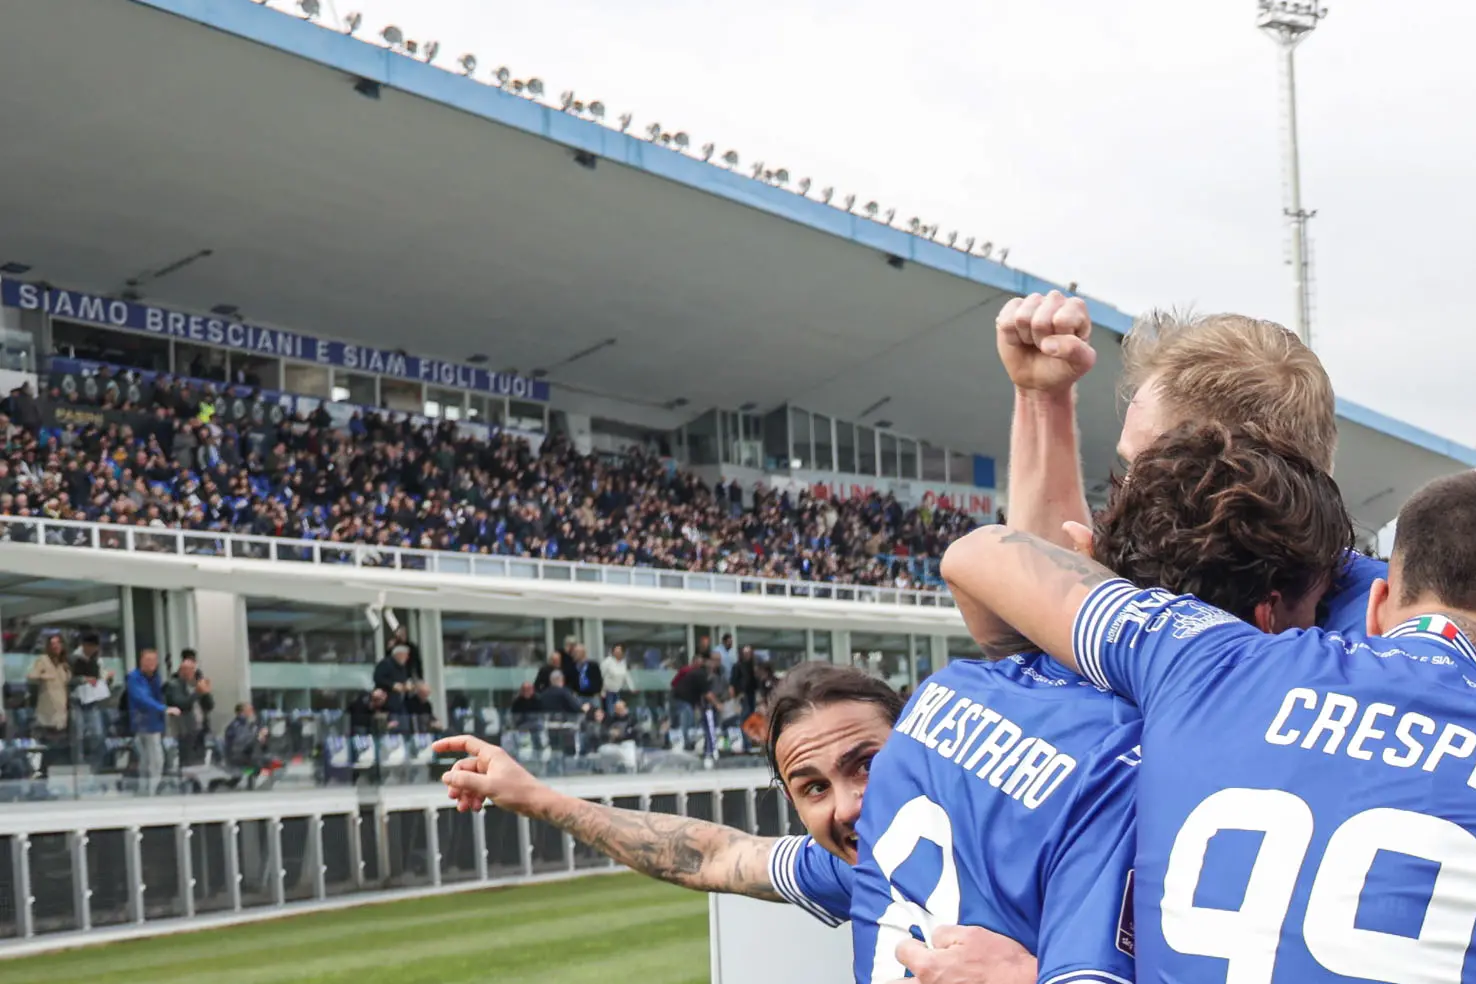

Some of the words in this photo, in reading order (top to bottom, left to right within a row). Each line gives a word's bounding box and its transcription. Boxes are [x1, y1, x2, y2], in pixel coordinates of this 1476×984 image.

[18, 283, 129, 326] SIAMO
[145, 307, 303, 357] BRESCIANI
[316, 340, 330, 362] E
[342, 345, 407, 377] SIAM
[418, 359, 476, 389] FIGLI
[488, 371, 534, 397] TUOI
